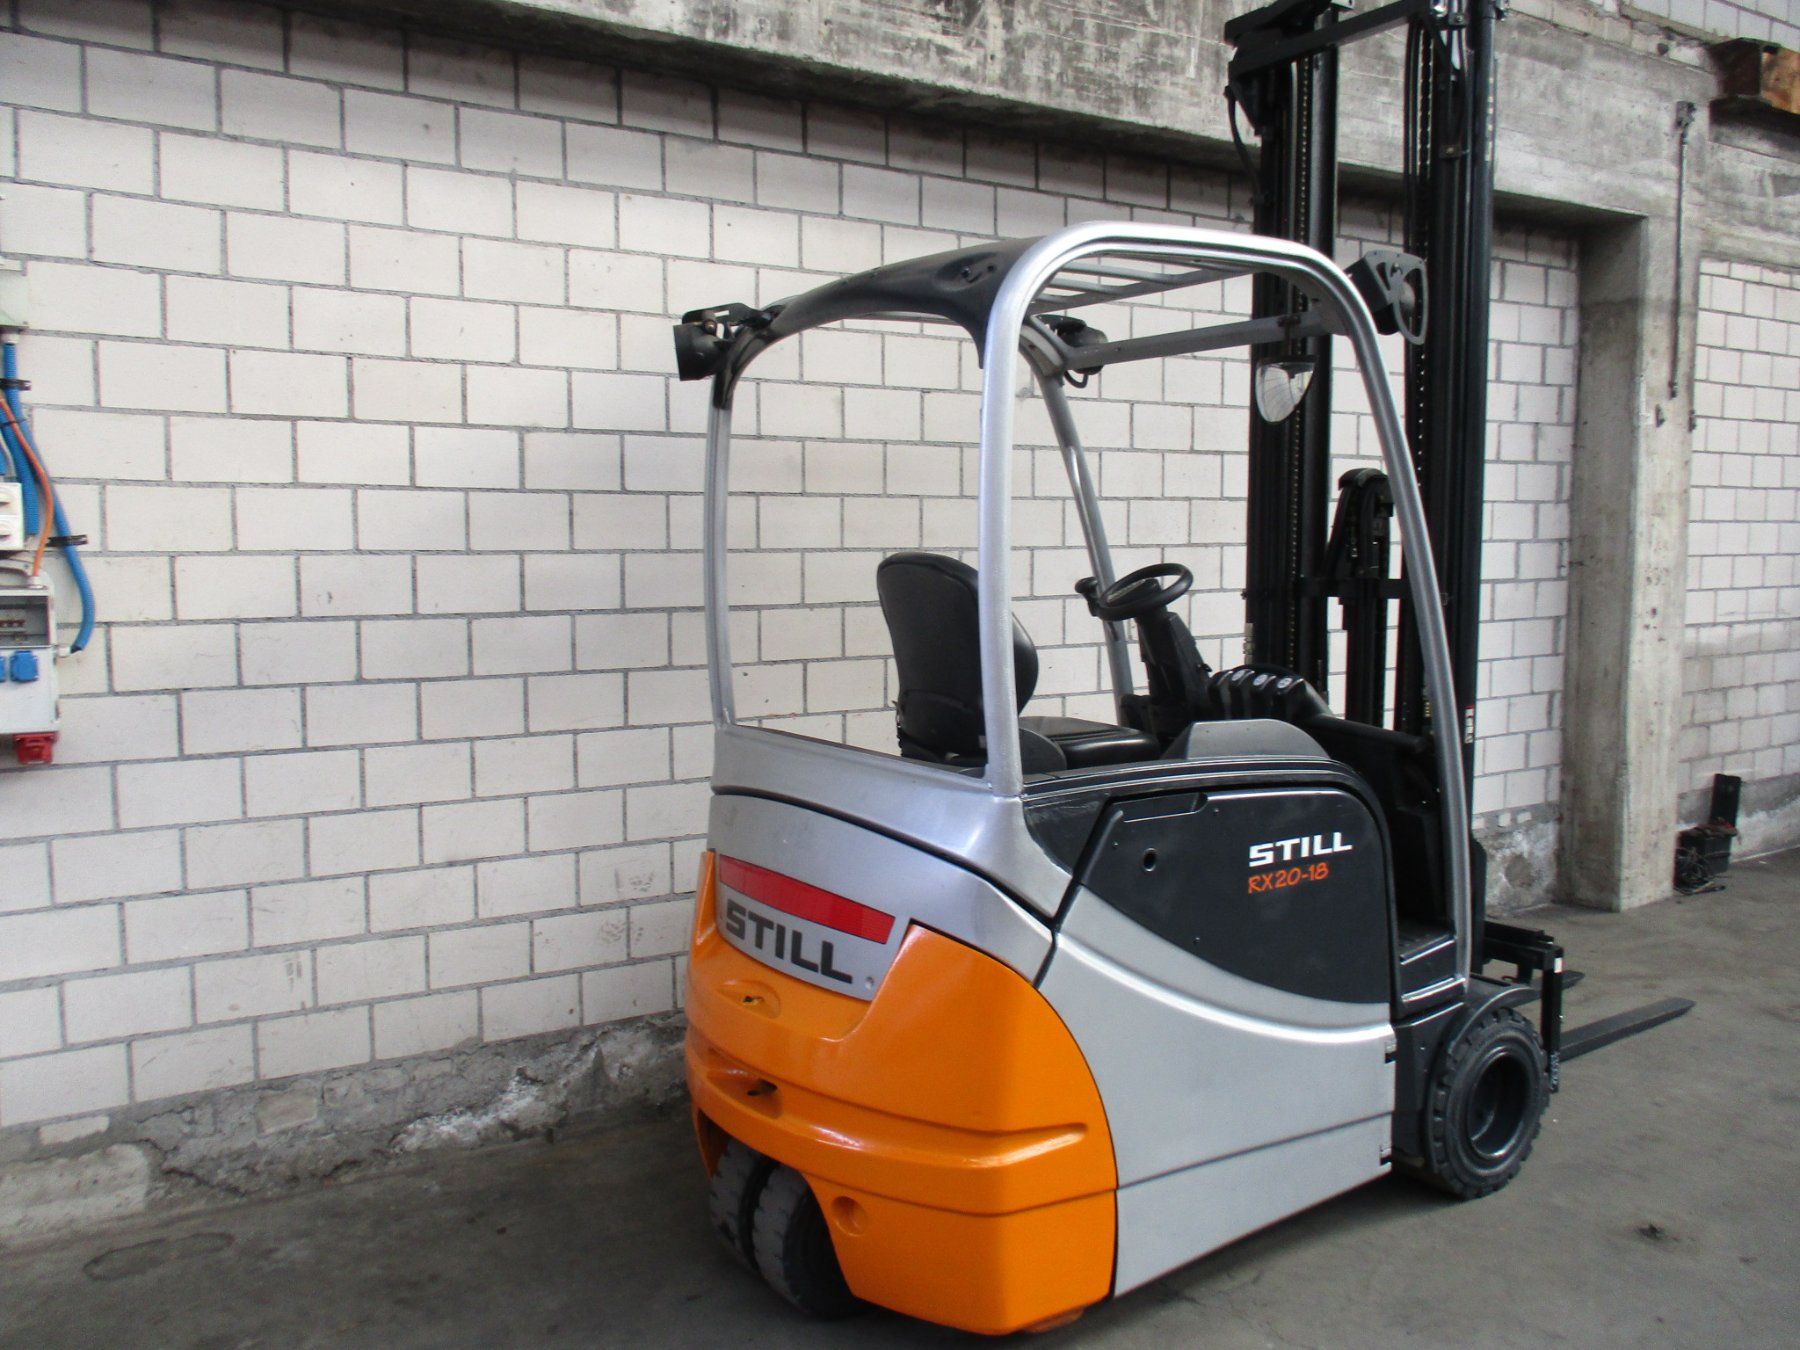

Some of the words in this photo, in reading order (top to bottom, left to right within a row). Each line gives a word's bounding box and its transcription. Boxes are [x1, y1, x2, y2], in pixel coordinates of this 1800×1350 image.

[1248, 832, 1353, 867] STILL
[1248, 862, 1329, 894] RX20-18
[726, 899, 853, 984] STILL
